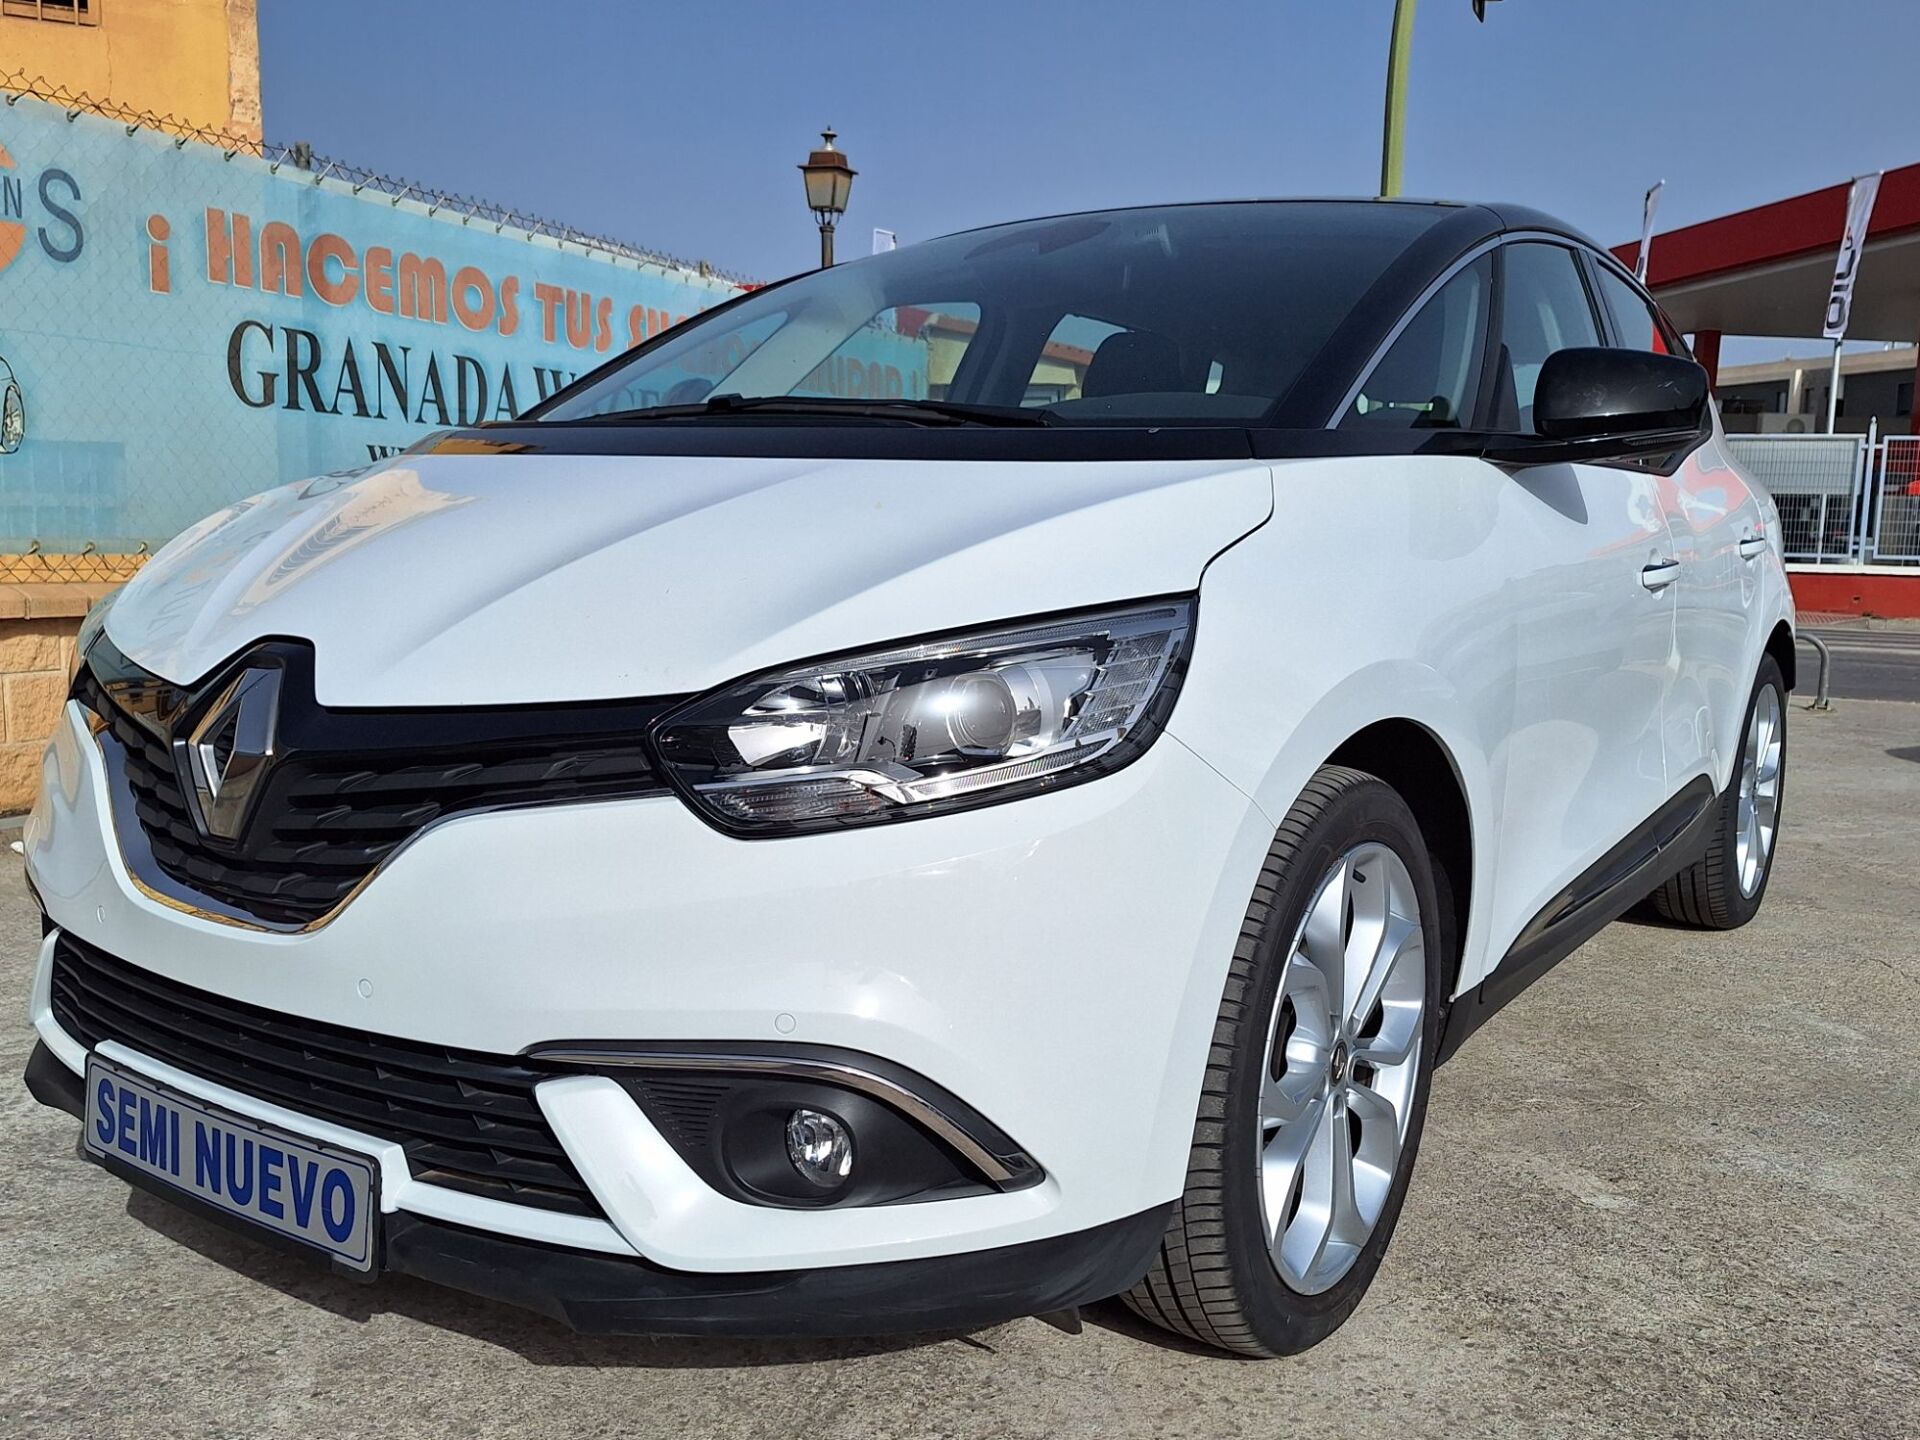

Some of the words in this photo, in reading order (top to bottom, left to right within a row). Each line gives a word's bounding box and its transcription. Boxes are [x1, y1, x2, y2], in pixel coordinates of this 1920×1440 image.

[38, 168, 84, 262] S
[204, 207, 520, 337] HACEMOS
[533, 282, 613, 354] TUS
[227, 319, 520, 428] GRANADA
[96, 1078, 180, 1177] SEMI
[195, 1121, 355, 1243] NUEVO
